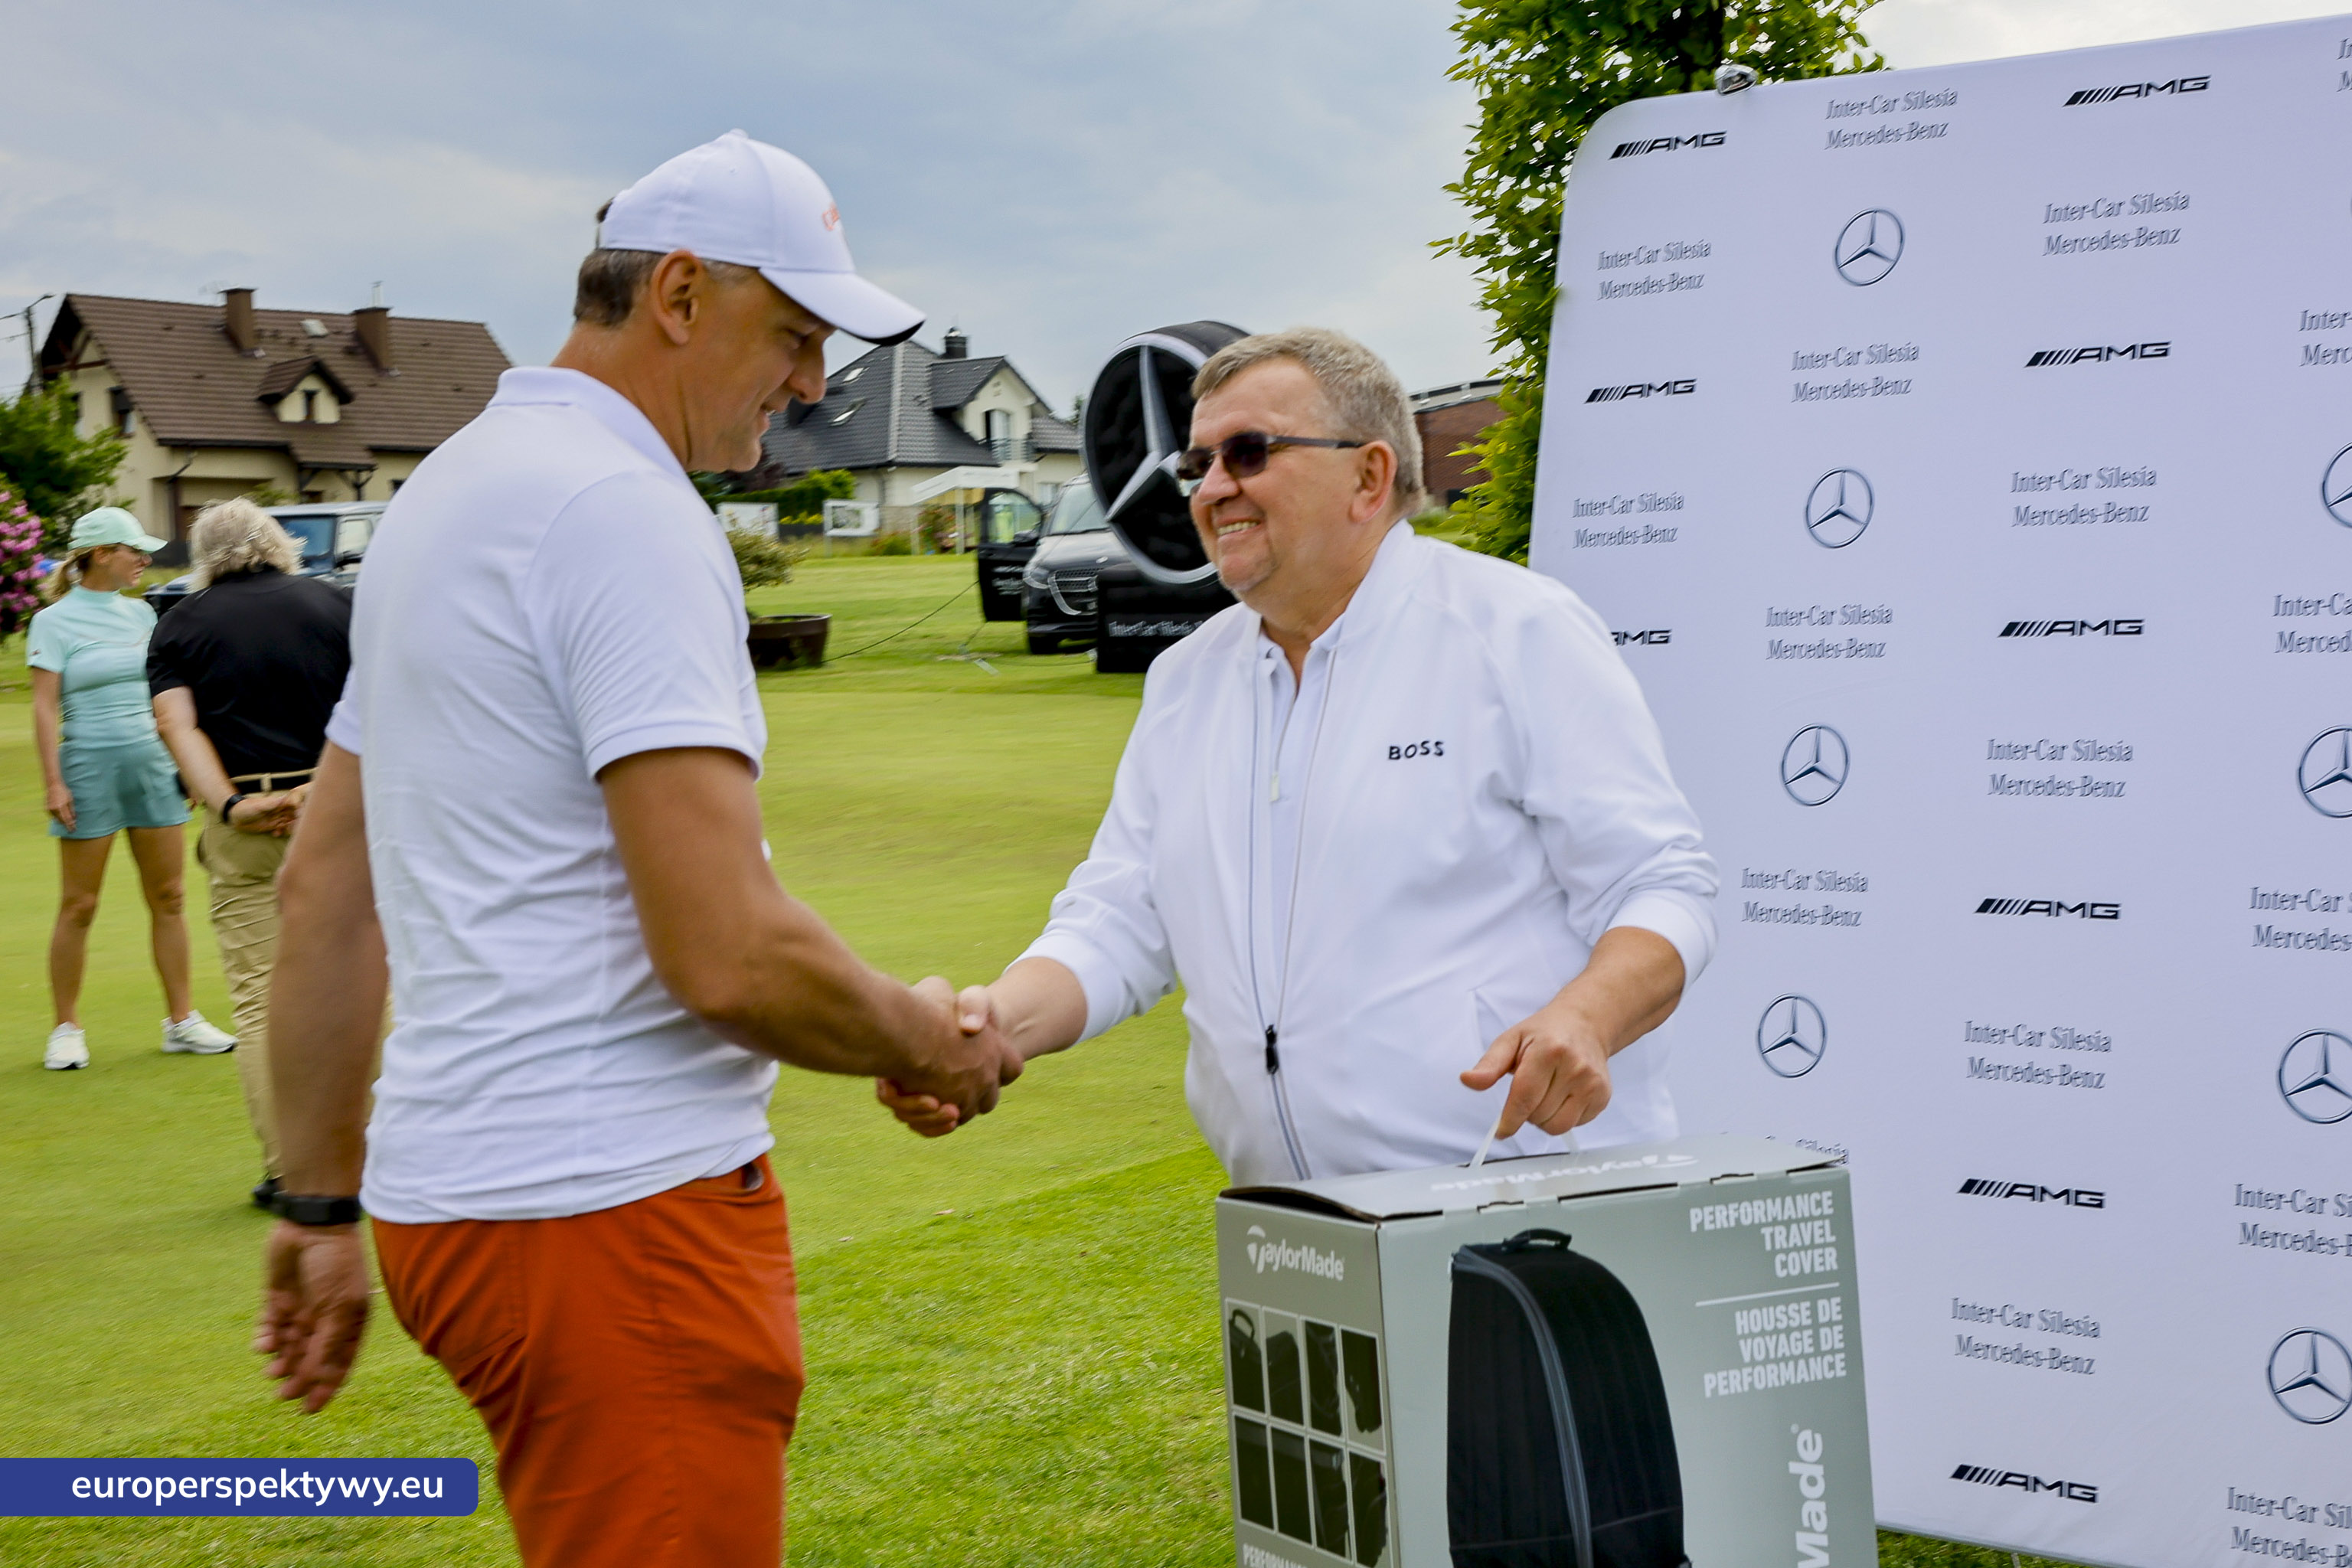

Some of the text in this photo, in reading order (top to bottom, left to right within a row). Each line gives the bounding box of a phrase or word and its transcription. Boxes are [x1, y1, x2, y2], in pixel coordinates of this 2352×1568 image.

[2111, 74, 2212, 101] AMG
[1825, 88, 1958, 120] Inter-Car Silesia
[1645, 130, 1727, 152] AMG
[1824, 122, 1950, 151] Mercedes-Benz
[2042, 190, 2190, 224] Inter-Car Silesia
[1597, 239, 1712, 271] Inter-Car Silesia
[2041, 227, 2182, 256] Mercedes-Benz
[1597, 272, 1705, 301] Mercedes-Benz
[1791, 341, 1920, 372] Inter-Car Silesia
[2072, 340, 2172, 364] AMG
[1619, 377, 1698, 400] AMG
[1791, 375, 1913, 403] Mercedes-Benz
[2010, 466, 2158, 494] Inter-Car Silesia
[1572, 491, 1685, 519] Inter-Car Silesia
[2010, 501, 2151, 528] Mercedes-Benz
[1572, 523, 1679, 550] Mercedes-Benz
[1765, 603, 1893, 629] Inter-Car Silesia
[2043, 618, 2145, 638] AMG
[1765, 638, 1887, 661] Mercedes-Benz
[1387, 740, 1444, 760] BOSS
[1986, 737, 2134, 763] Inter-Car Silesia
[1987, 773, 2127, 798] Mercedes-Benz
[1740, 867, 1870, 893] Inter-Car Silesia
[1741, 900, 1863, 928] Mercedes-Benz
[2019, 899, 2122, 920] AMG
[2249, 886, 2344, 913] Inter-Car
[1963, 1020, 2112, 1053] Inter-Car Silesia
[1965, 1055, 2106, 1089] Mercedes-Benz
[2006, 1183, 2107, 1210] AMG
[2233, 1183, 2328, 1215] Inter-Car
[1689, 1190, 1834, 1233] PERFORMANCE
[1760, 1219, 1836, 1251] TRAVEL
[1246, 1225, 1345, 1282] TaylorMade
[1774, 1246, 1838, 1279] COVER
[1734, 1296, 1843, 1336] HOUSSE DE
[1950, 1297, 2101, 1339] Inter-Car Silesia
[1739, 1325, 1845, 1364] VOYAGE DE
[1954, 1334, 2096, 1376] Mercedes-Benz
[1704, 1352, 1847, 1399] PERFORMANCE
[1995, 1471, 2100, 1504] AMG
[2226, 1486, 2320, 1524] Inter-Car
